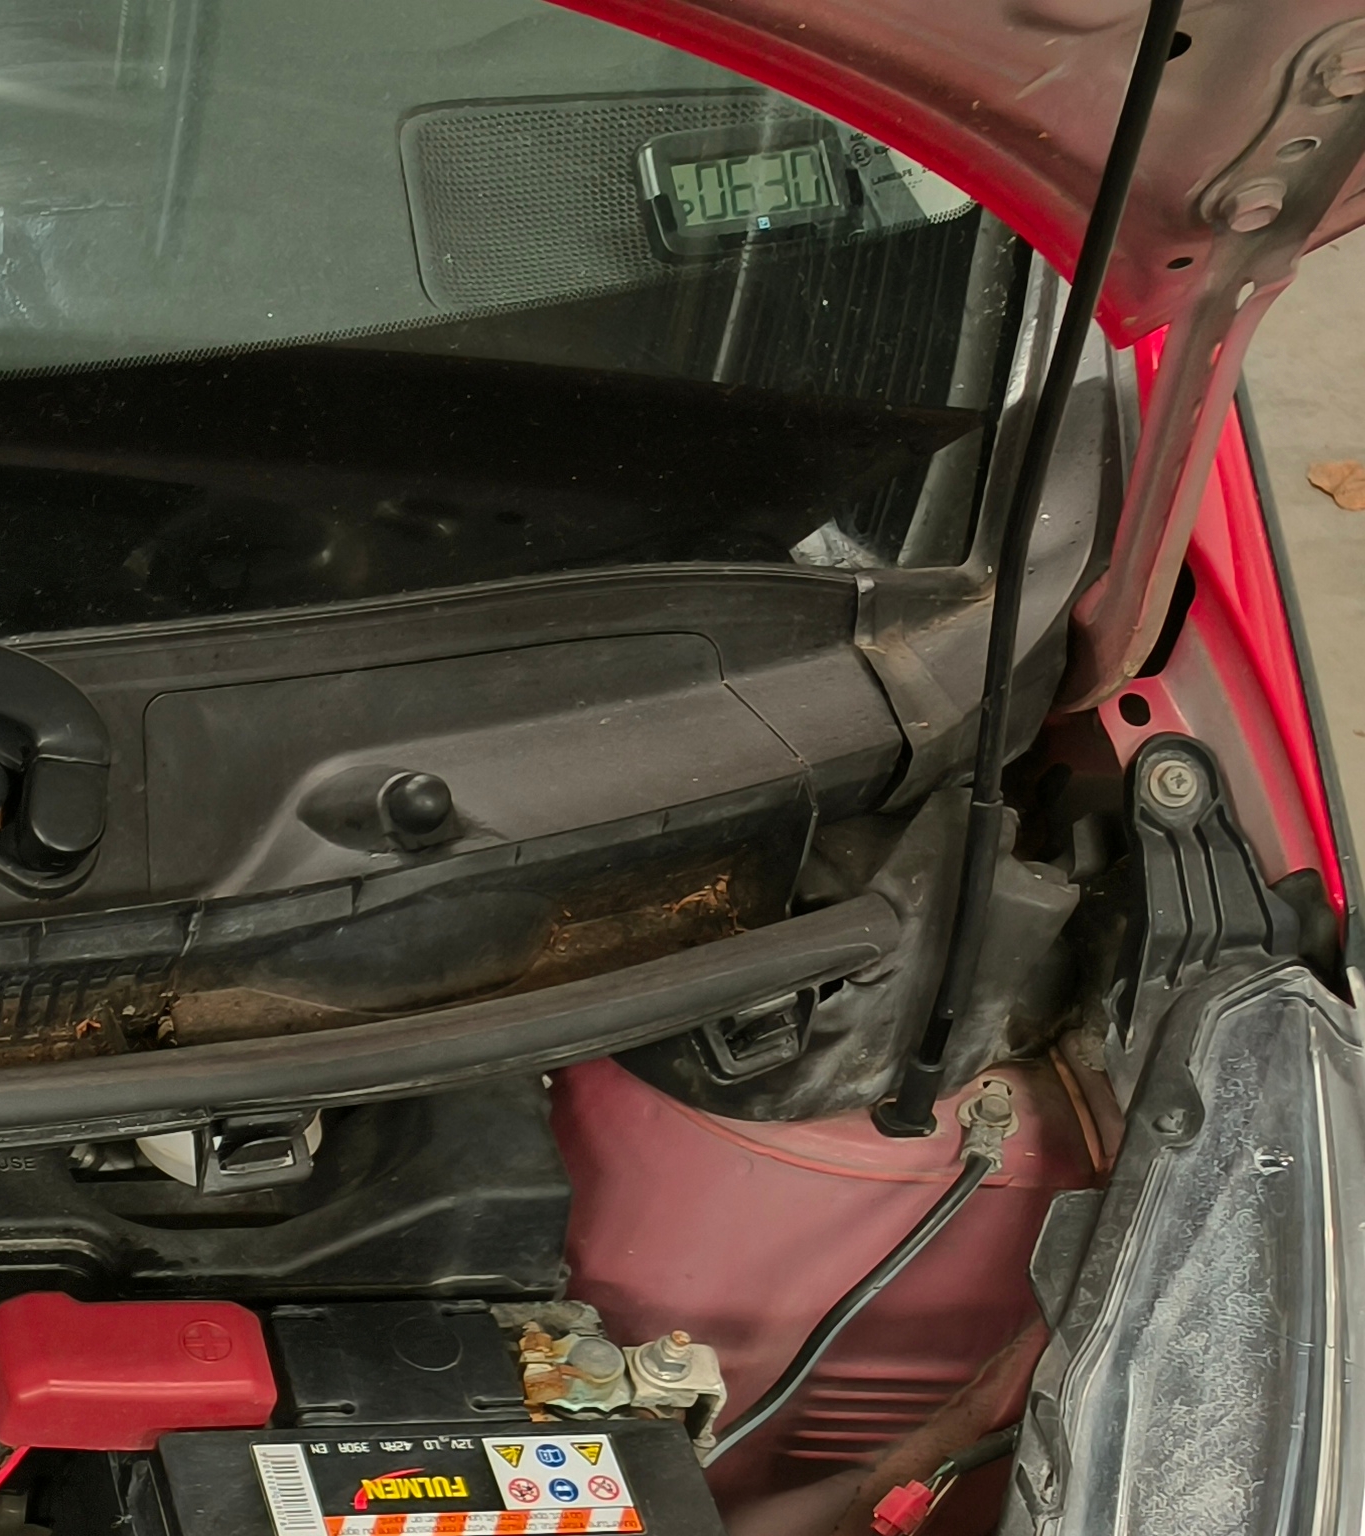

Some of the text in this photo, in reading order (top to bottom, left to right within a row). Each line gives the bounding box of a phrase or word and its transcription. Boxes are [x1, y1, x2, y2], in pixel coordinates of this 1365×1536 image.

[309, 1443, 329, 1454] EN
[337, 1441, 371, 1453] 390A
[379, 1440, 414, 1452] 42Ah
[451, 1438, 474, 1450] 12V
[361, 1476, 469, 1500] FULMEN
